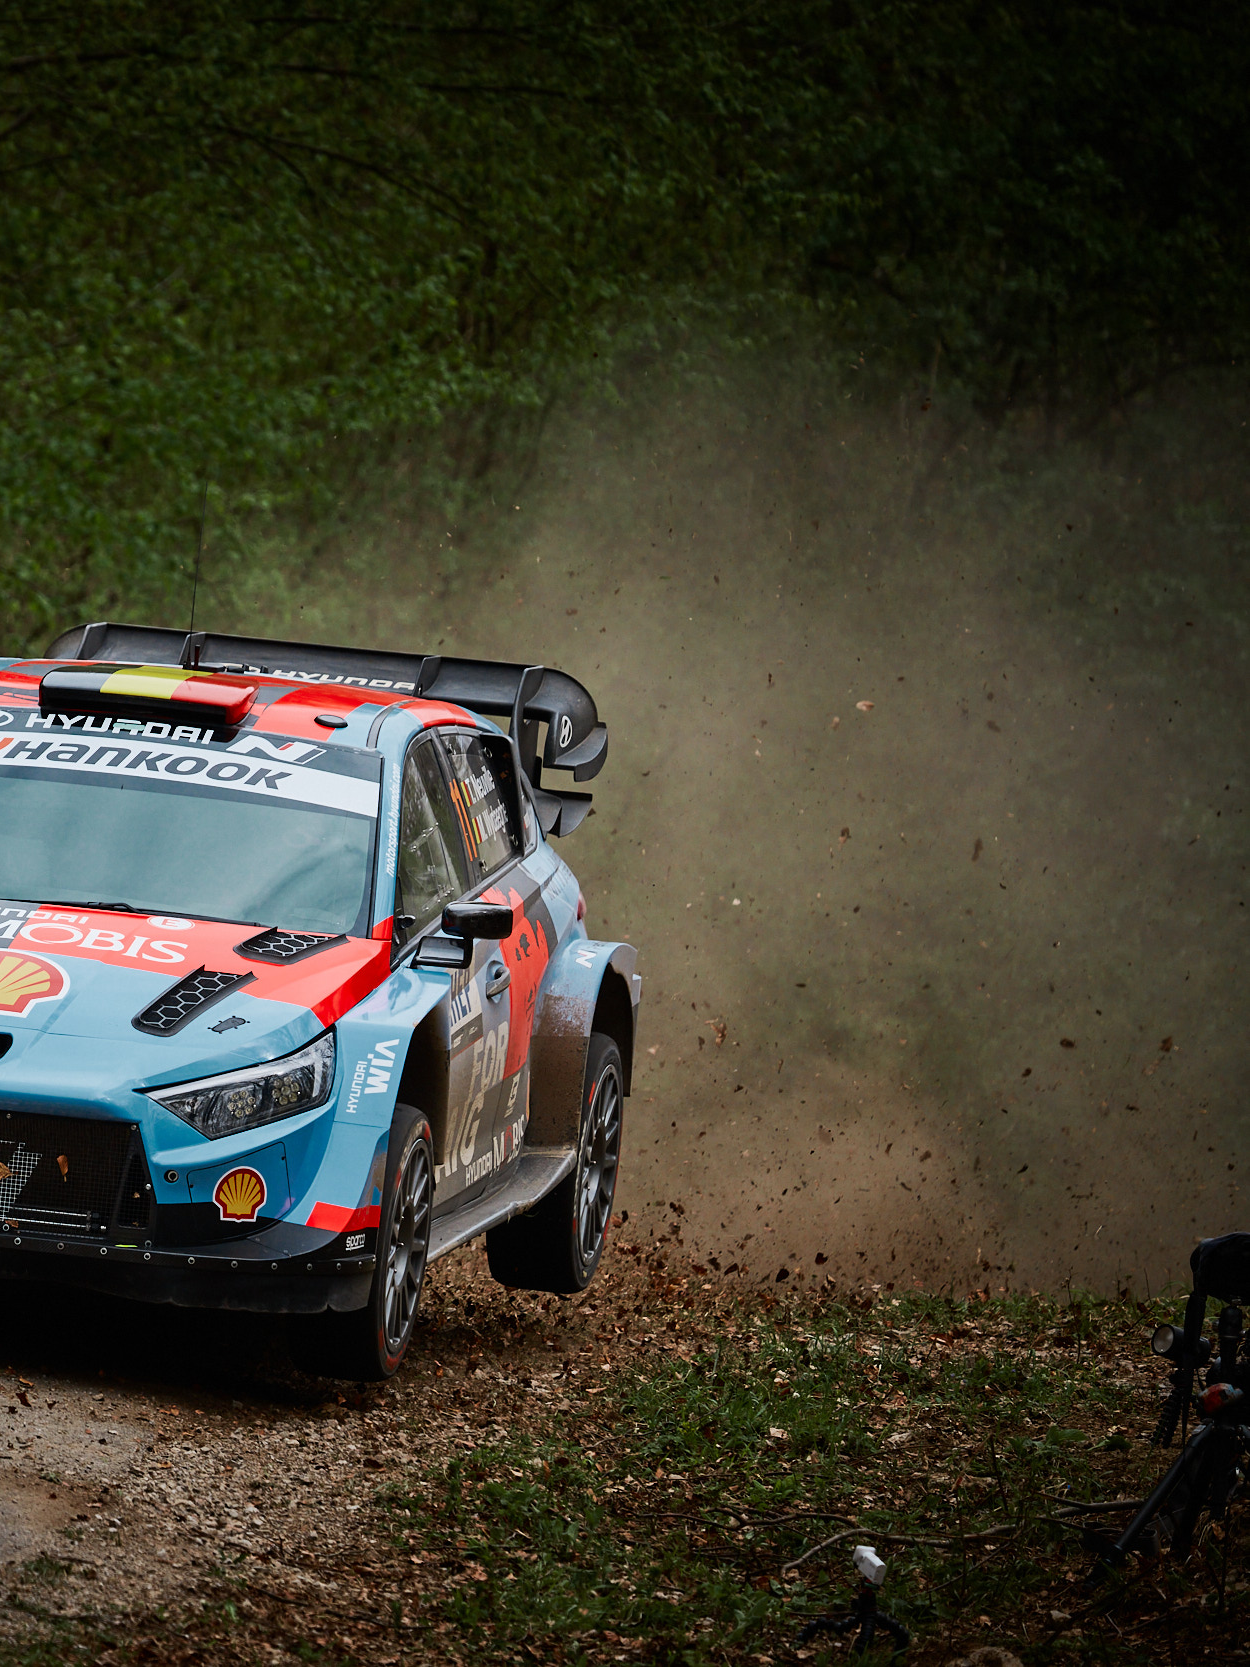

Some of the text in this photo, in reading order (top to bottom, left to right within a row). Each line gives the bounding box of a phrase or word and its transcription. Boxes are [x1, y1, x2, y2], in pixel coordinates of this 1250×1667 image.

[269, 669, 416, 691] HYUNDA
[25, 712, 215, 745] HYUNDAI
[345, 1060, 368, 1114] HYUNDAI
